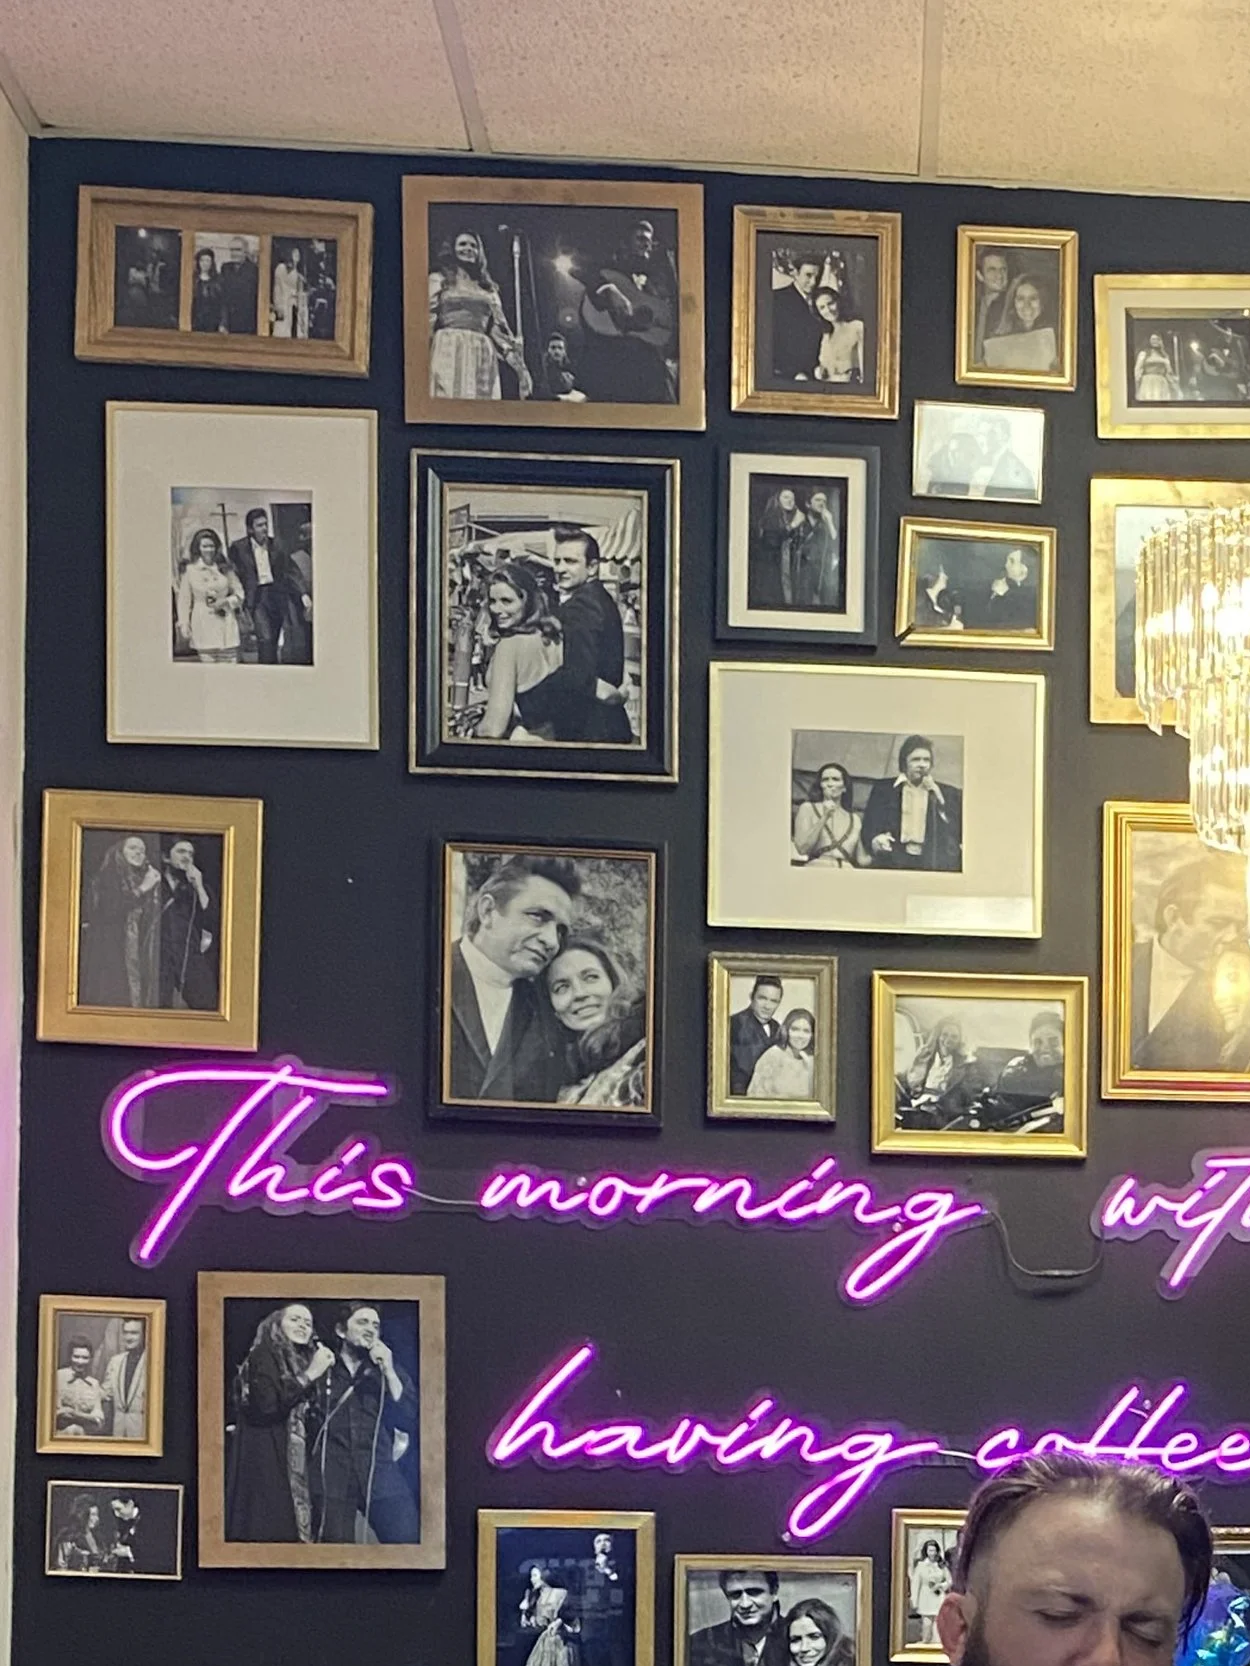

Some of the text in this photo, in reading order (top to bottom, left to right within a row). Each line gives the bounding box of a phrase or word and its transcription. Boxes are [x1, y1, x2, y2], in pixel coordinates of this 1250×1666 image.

[110, 1063, 414, 1260] This
[480, 1157, 982, 1300] morning
[491, 1346, 939, 1541] having
